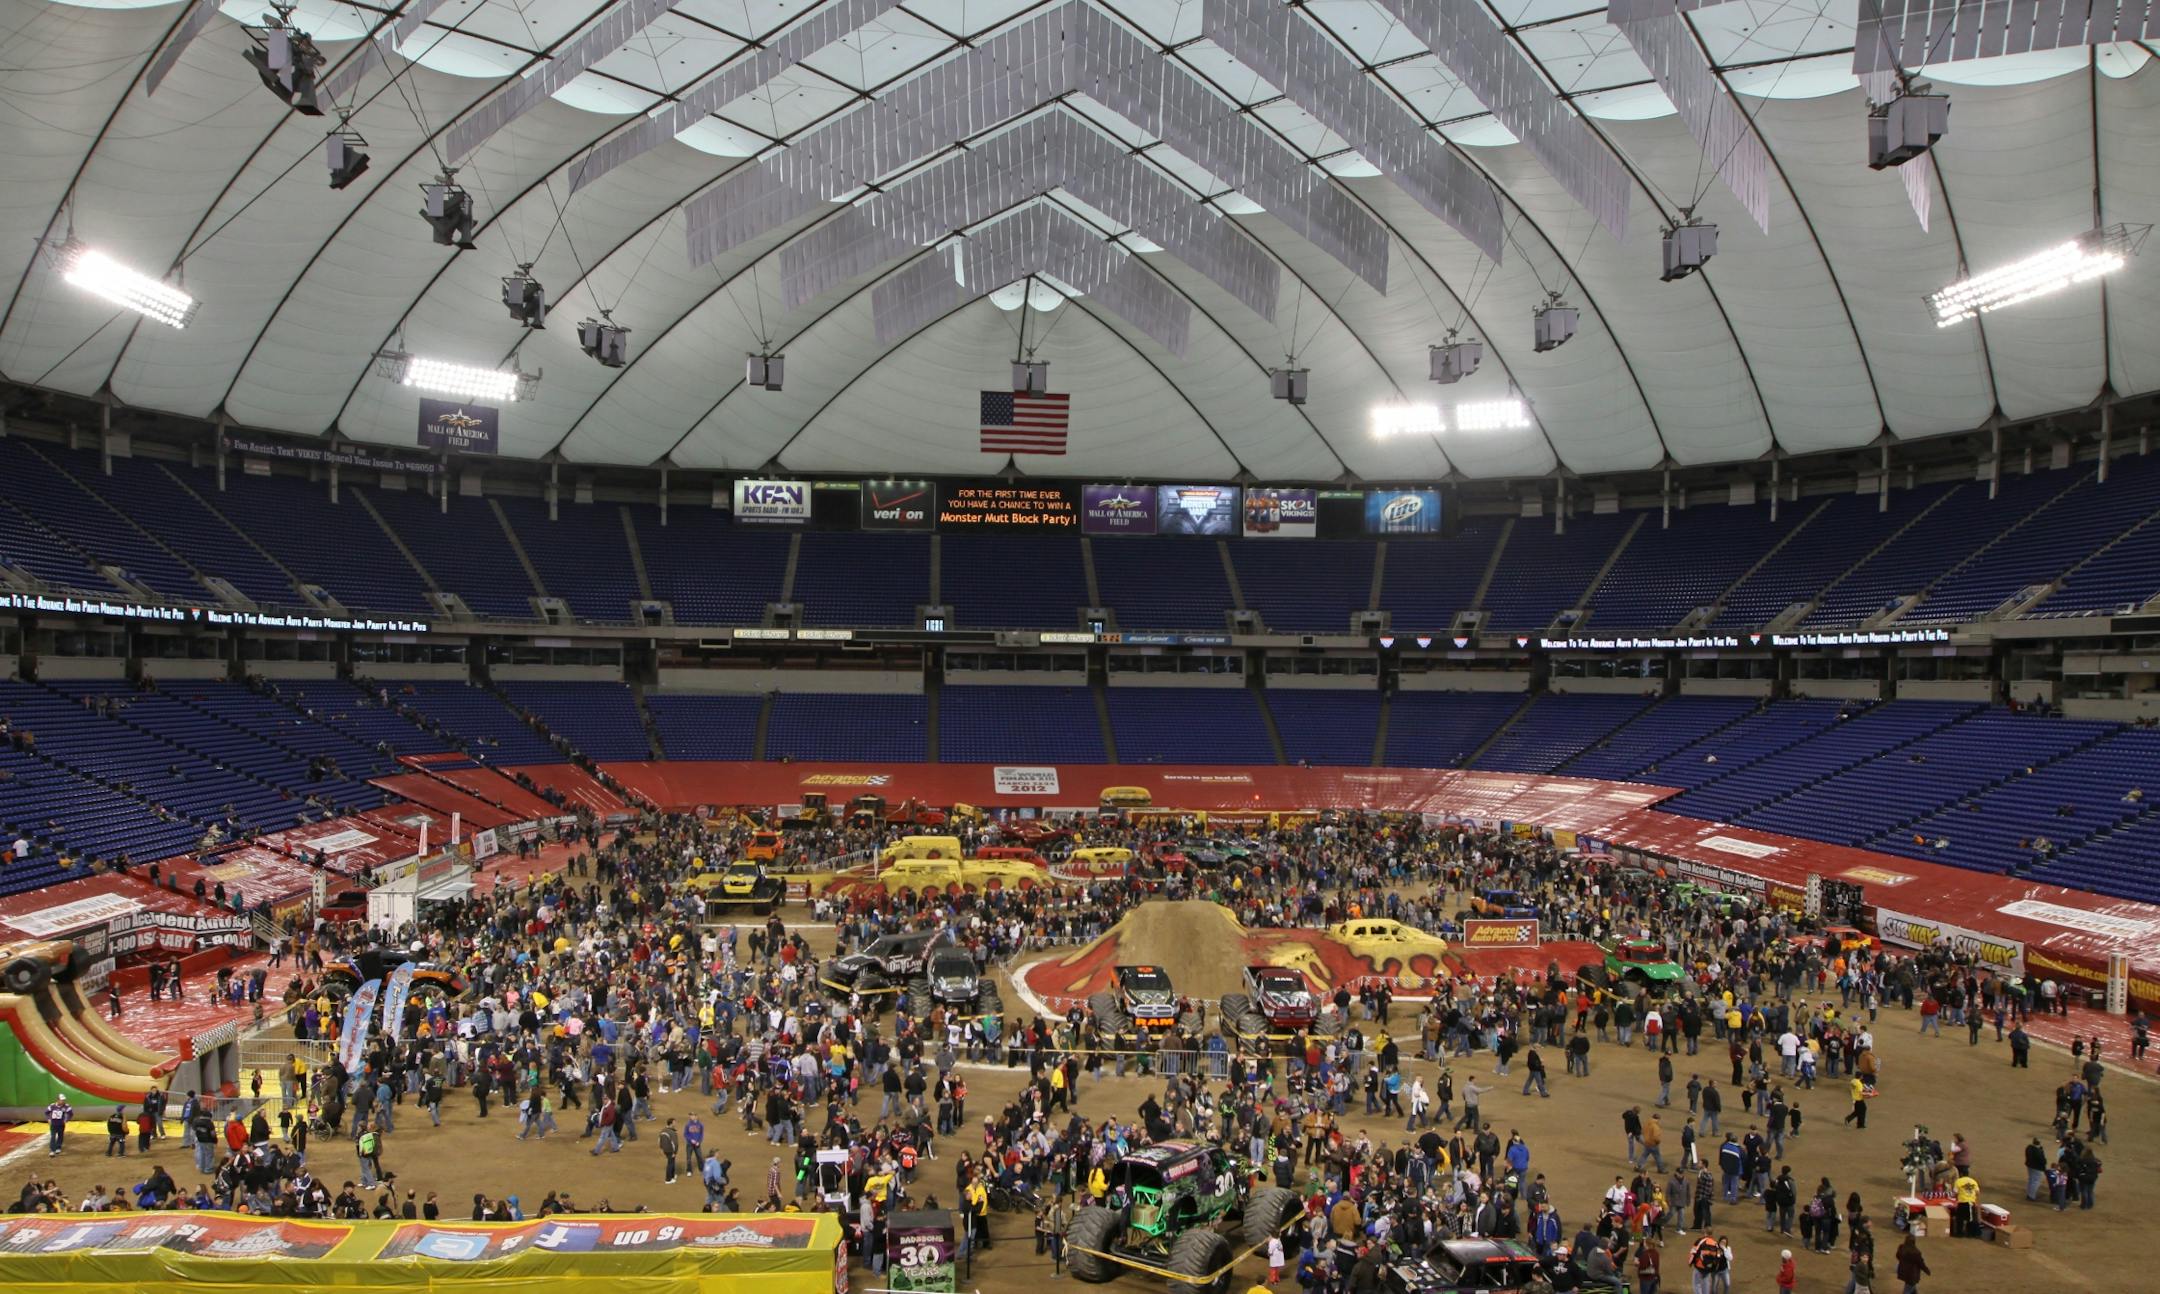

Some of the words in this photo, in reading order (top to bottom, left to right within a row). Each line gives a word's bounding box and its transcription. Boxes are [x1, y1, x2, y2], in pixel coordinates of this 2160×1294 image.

[427, 424, 444, 436] MALL
[455, 425, 489, 440] AMERICA
[234, 439, 248, 450] Fan
[448, 437, 470, 447] FIELD
[743, 485, 803, 505] KFAN
[958, 489, 976, 498] FOR
[977, 490, 993, 498] THE
[995, 490, 1017, 499] FIRST
[1019, 490, 1037, 499] TIME
[1039, 491, 1061, 500] EVER
[948, 500, 966, 508] YOU
[967, 500, 988, 509] HAVE
[990, 501, 997, 509] A
[999, 501, 1031, 510] CHANCE
[1032, 502, 1045, 510] TO
[1047, 502, 1063, 510] WIN
[1065, 502, 1071, 510] A
[874, 508, 924, 520] verizon
[940, 512, 983, 524] Monster
[984, 513, 1009, 523] Mutt
[1011, 513, 1039, 524] Block
[1042, 514, 1070, 527] Party
[1089, 509, 1106, 518] MALL
[1115, 509, 1148, 519] AMERICA
[1109, 518, 1130, 526] FIELD
[1678, 859, 1692, 873] Auto
[1692, 862, 1719, 879] Accident
[1719, 870, 1735, 884] Auto
[1735, 873, 1766, 891] Accident
[109, 917, 131, 933] Auto
[132, 911, 195, 930] Accident
[1476, 925, 1516, 934] Advance
[1471, 934, 1491, 942] Auto
[1491, 934, 1517, 942] Parts
[1884, 917, 1941, 946] SUBWAY
[1954, 935, 2018, 968] SUBWAY
[1135, 1017, 1175, 1026] RAM
[1214, 1171, 1235, 1198] 30
[174, 1223, 209, 1242] is
[613, 1229, 649, 1246] on
[656, 1225, 685, 1242] is
[500, 1235, 524, 1251] &
[900, 1245, 940, 1267] 30
[902, 1266, 941, 1277] YEARS
